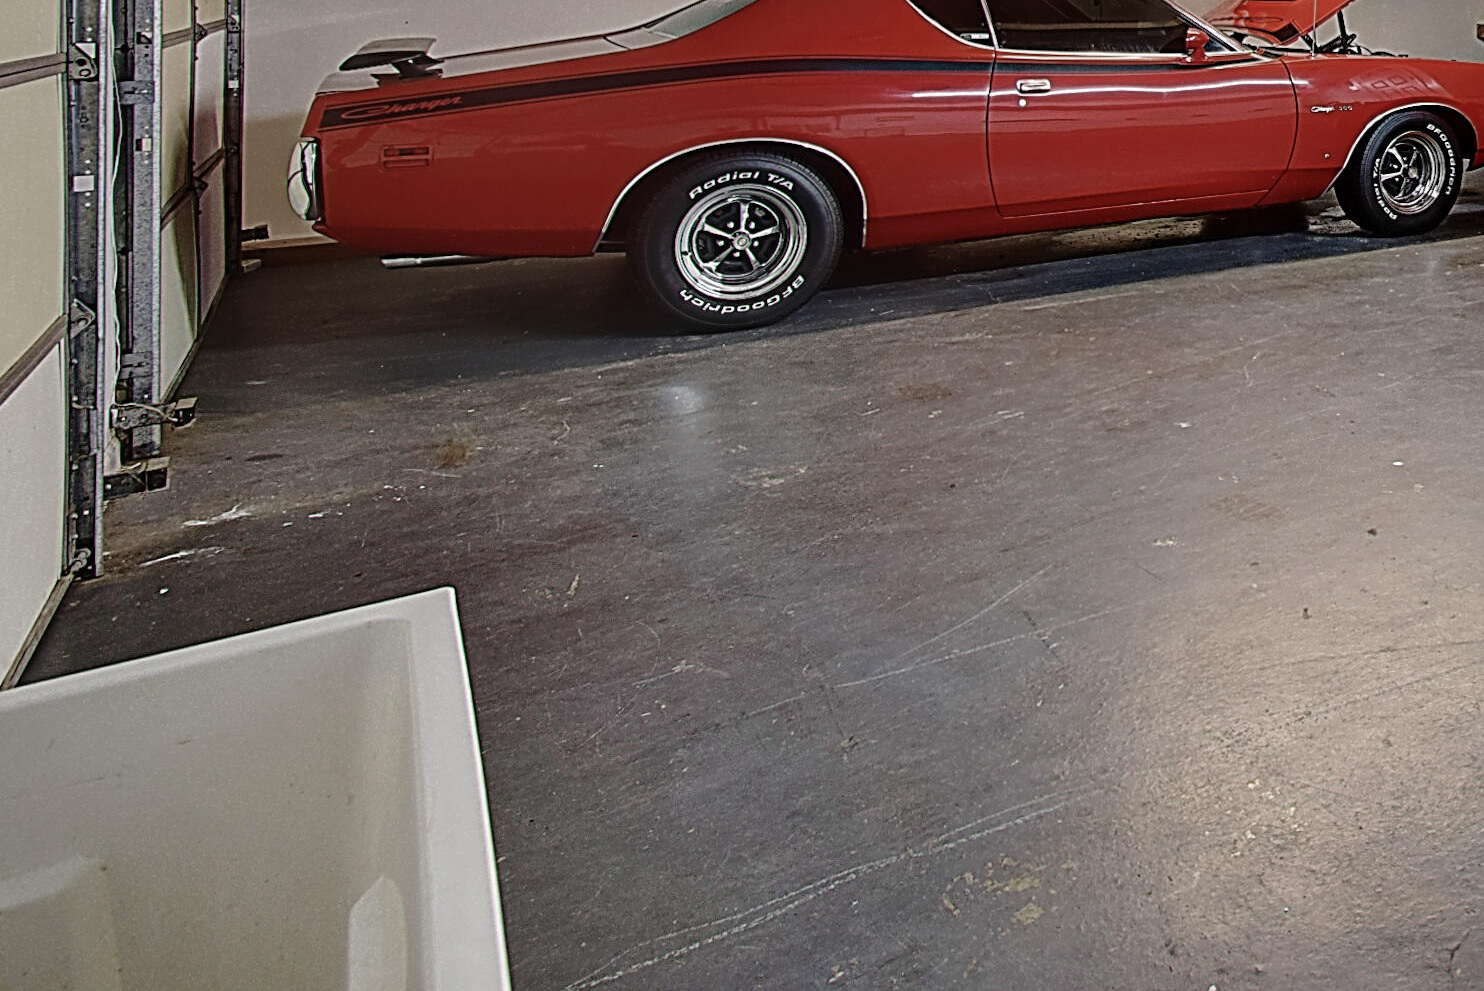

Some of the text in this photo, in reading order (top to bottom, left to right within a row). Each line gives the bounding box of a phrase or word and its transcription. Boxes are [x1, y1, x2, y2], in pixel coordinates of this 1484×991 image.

[341, 96, 461, 119] Charger
[1426, 123, 1456, 195] BFGoodrich
[688, 170, 795, 200] Radial T/A
[1372, 158, 1398, 220] Radial T/A
[679, 275, 805, 315] BFGoodrich
